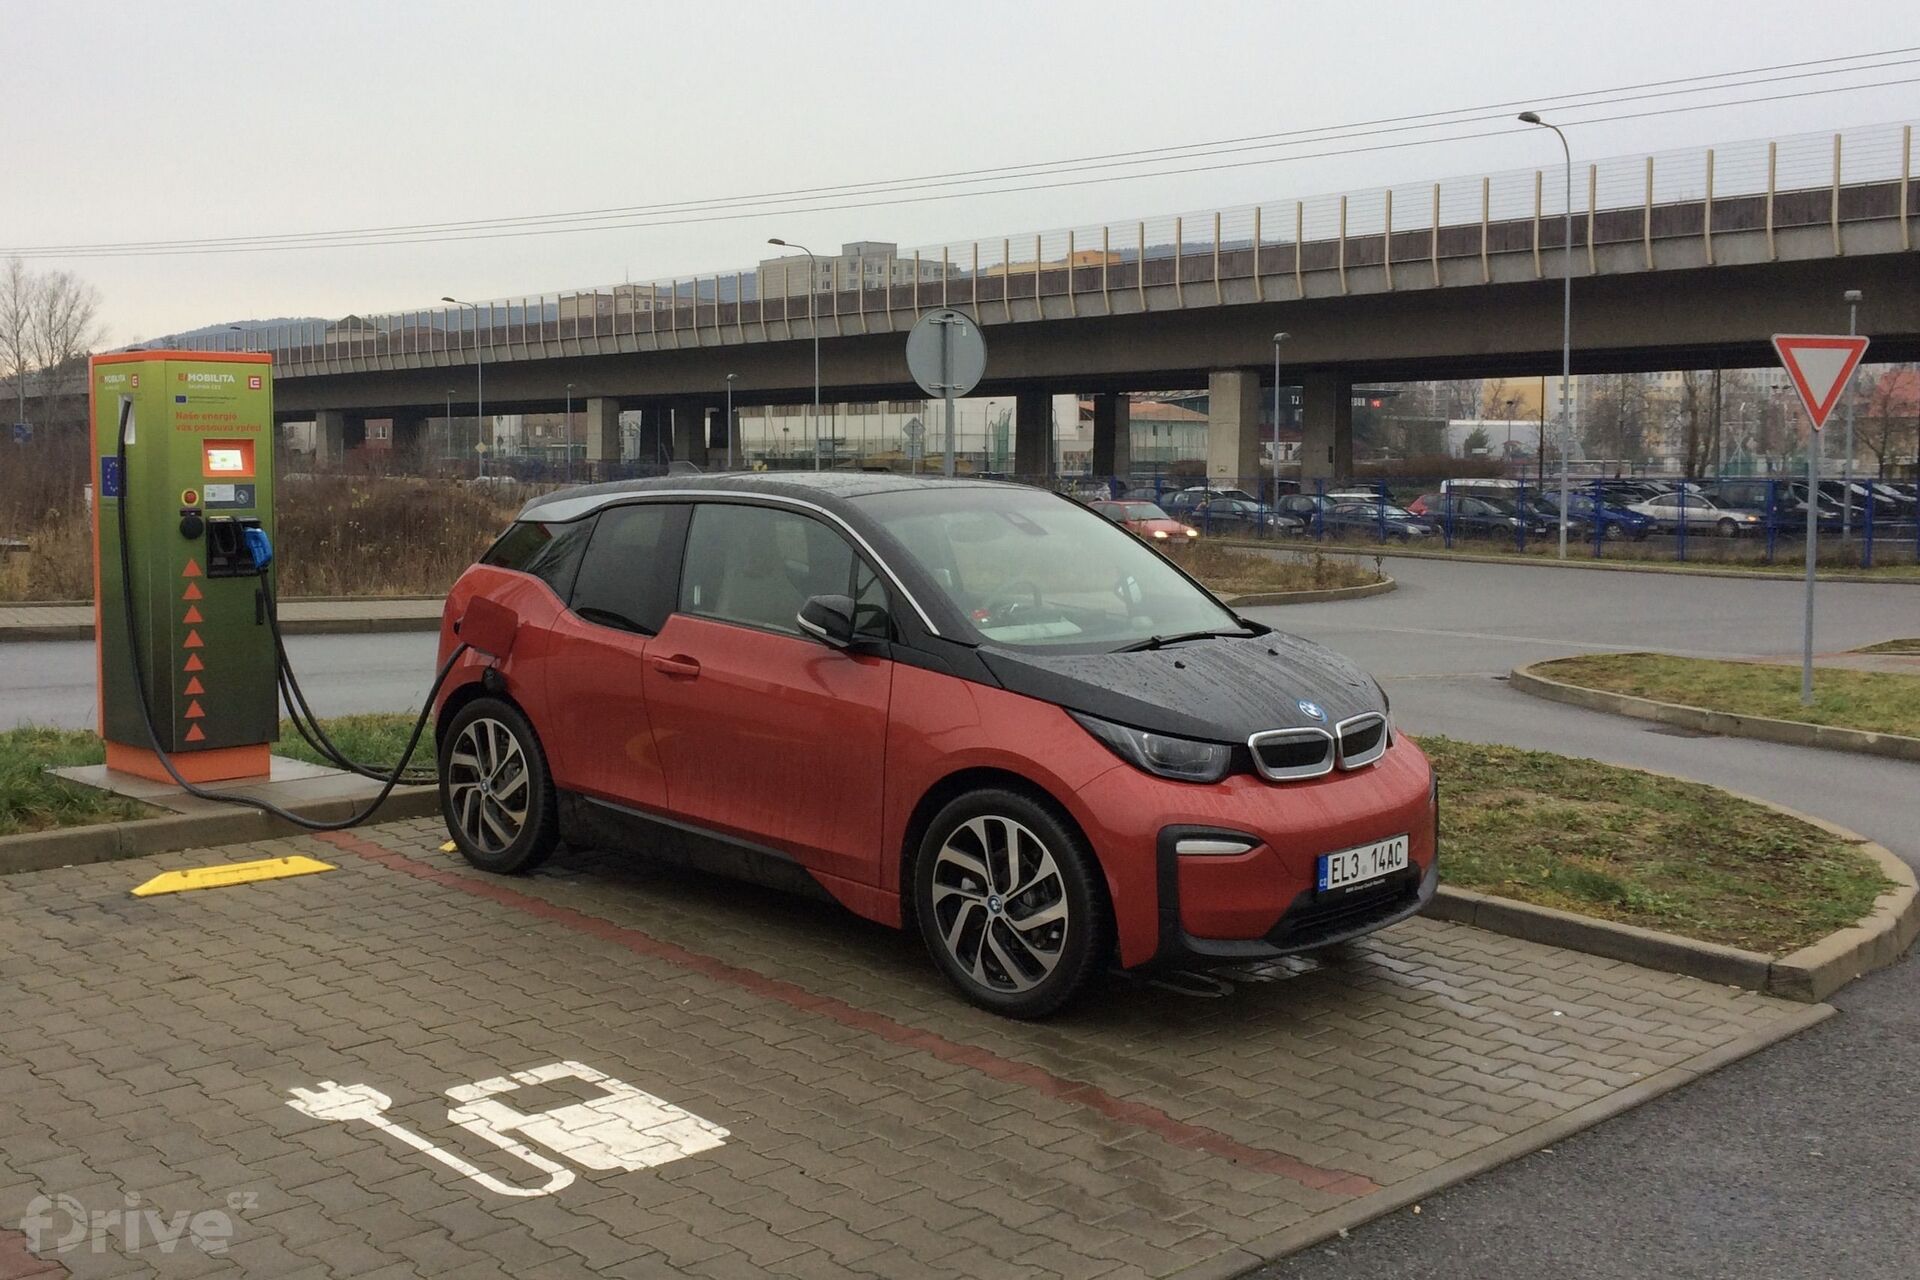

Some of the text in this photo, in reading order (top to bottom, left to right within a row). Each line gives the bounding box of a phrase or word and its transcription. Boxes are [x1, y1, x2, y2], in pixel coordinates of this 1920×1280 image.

[176, 411, 237, 421] Naše energie
[1332, 841, 1402, 884] EL3 14AC
[1319, 878, 1327, 887] CZ
